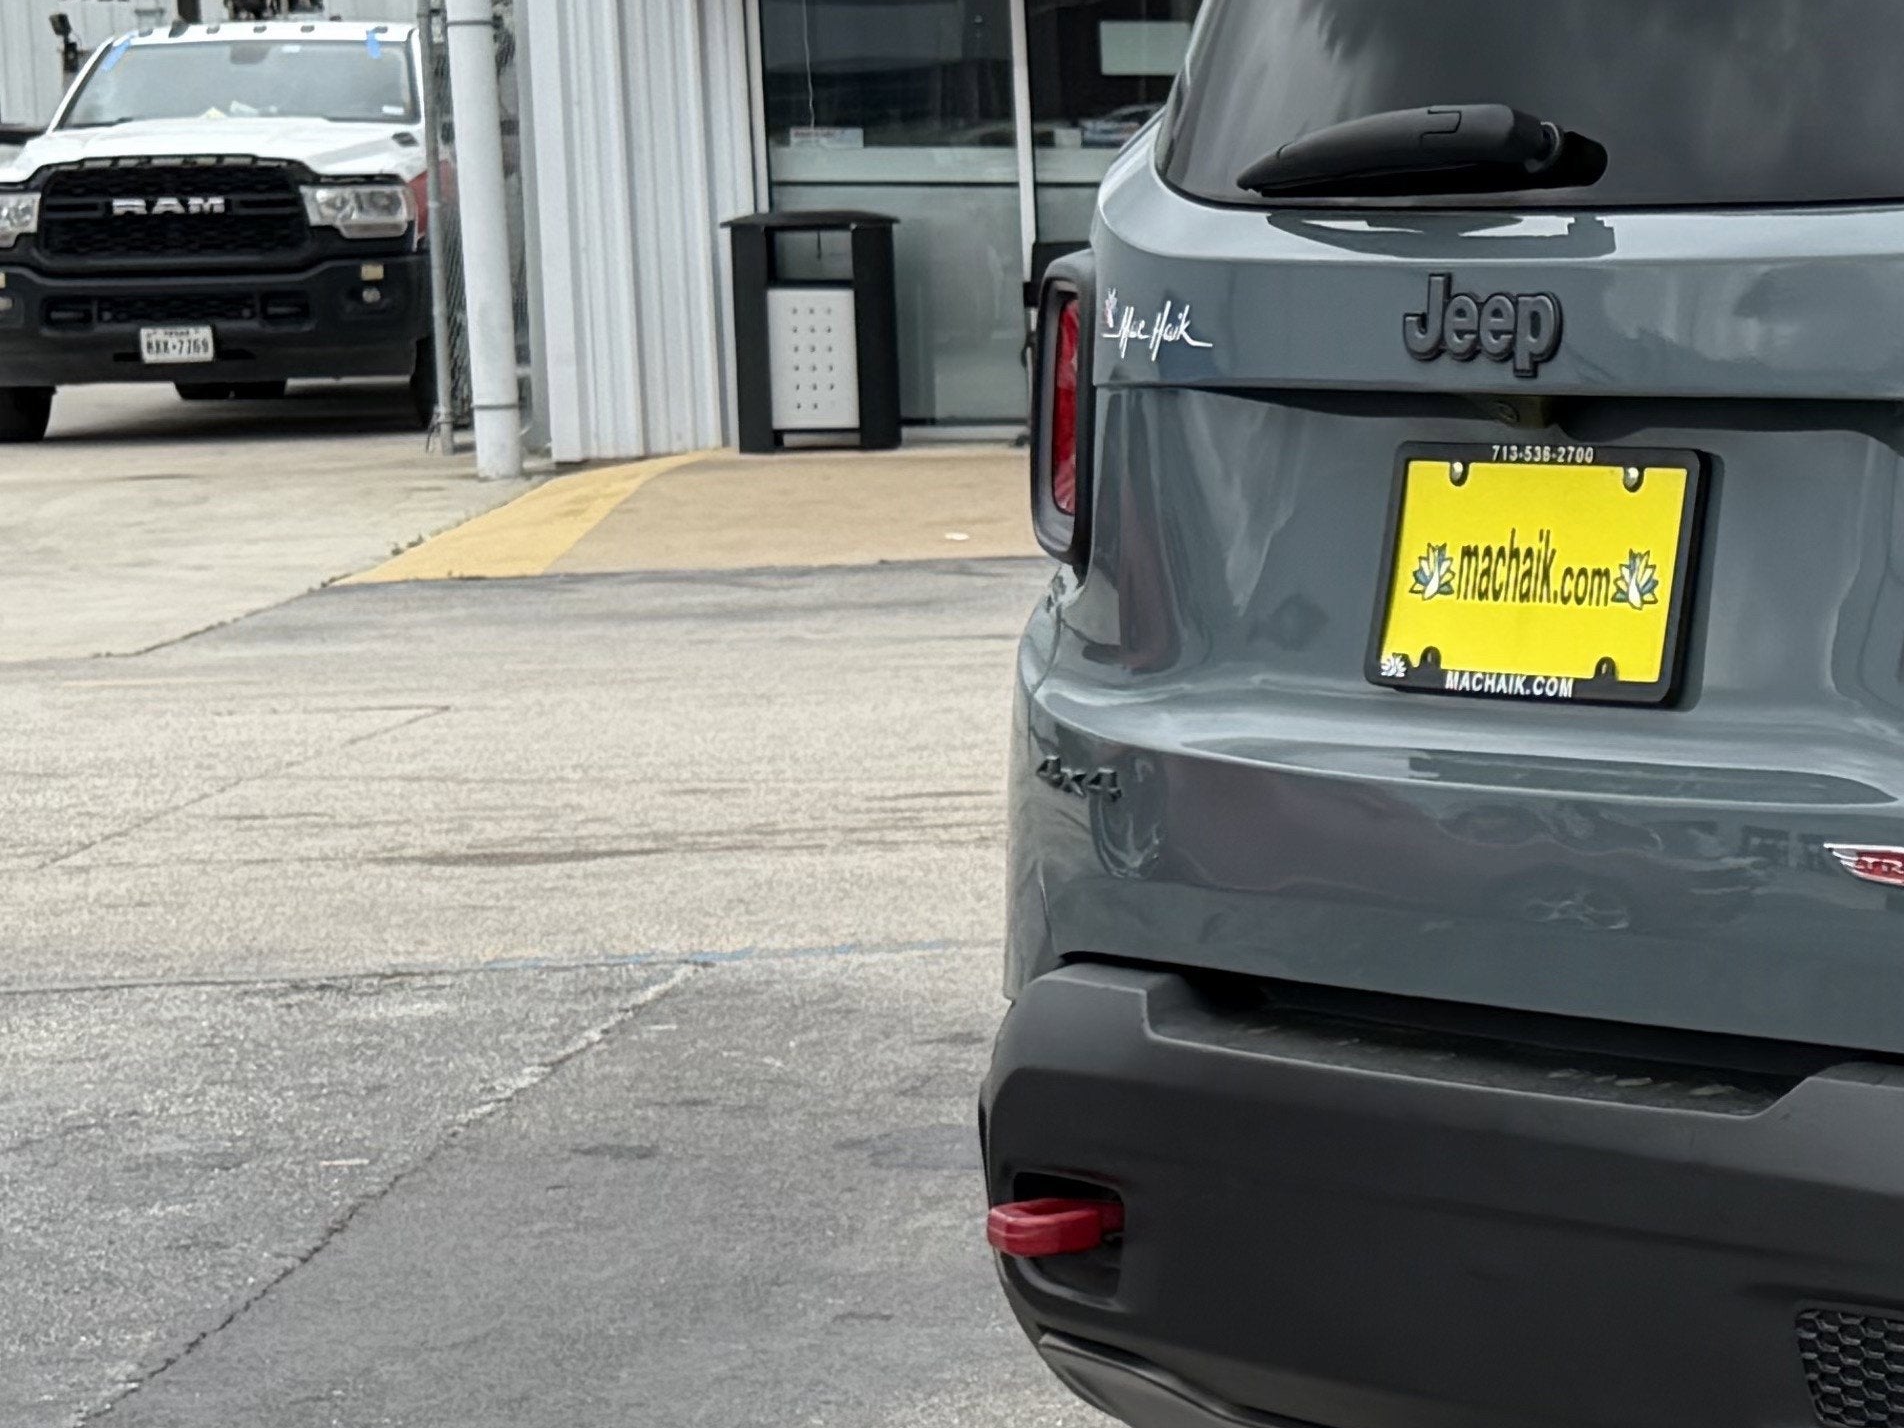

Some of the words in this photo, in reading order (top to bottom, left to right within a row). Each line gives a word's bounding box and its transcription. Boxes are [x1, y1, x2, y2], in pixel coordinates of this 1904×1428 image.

[111, 197, 226, 215] RAM
[1402, 272, 1564, 379] Jeep
[1456, 527, 1611, 607] machaik.com
[1444, 670, 1574, 698] MACHAIK.COM
